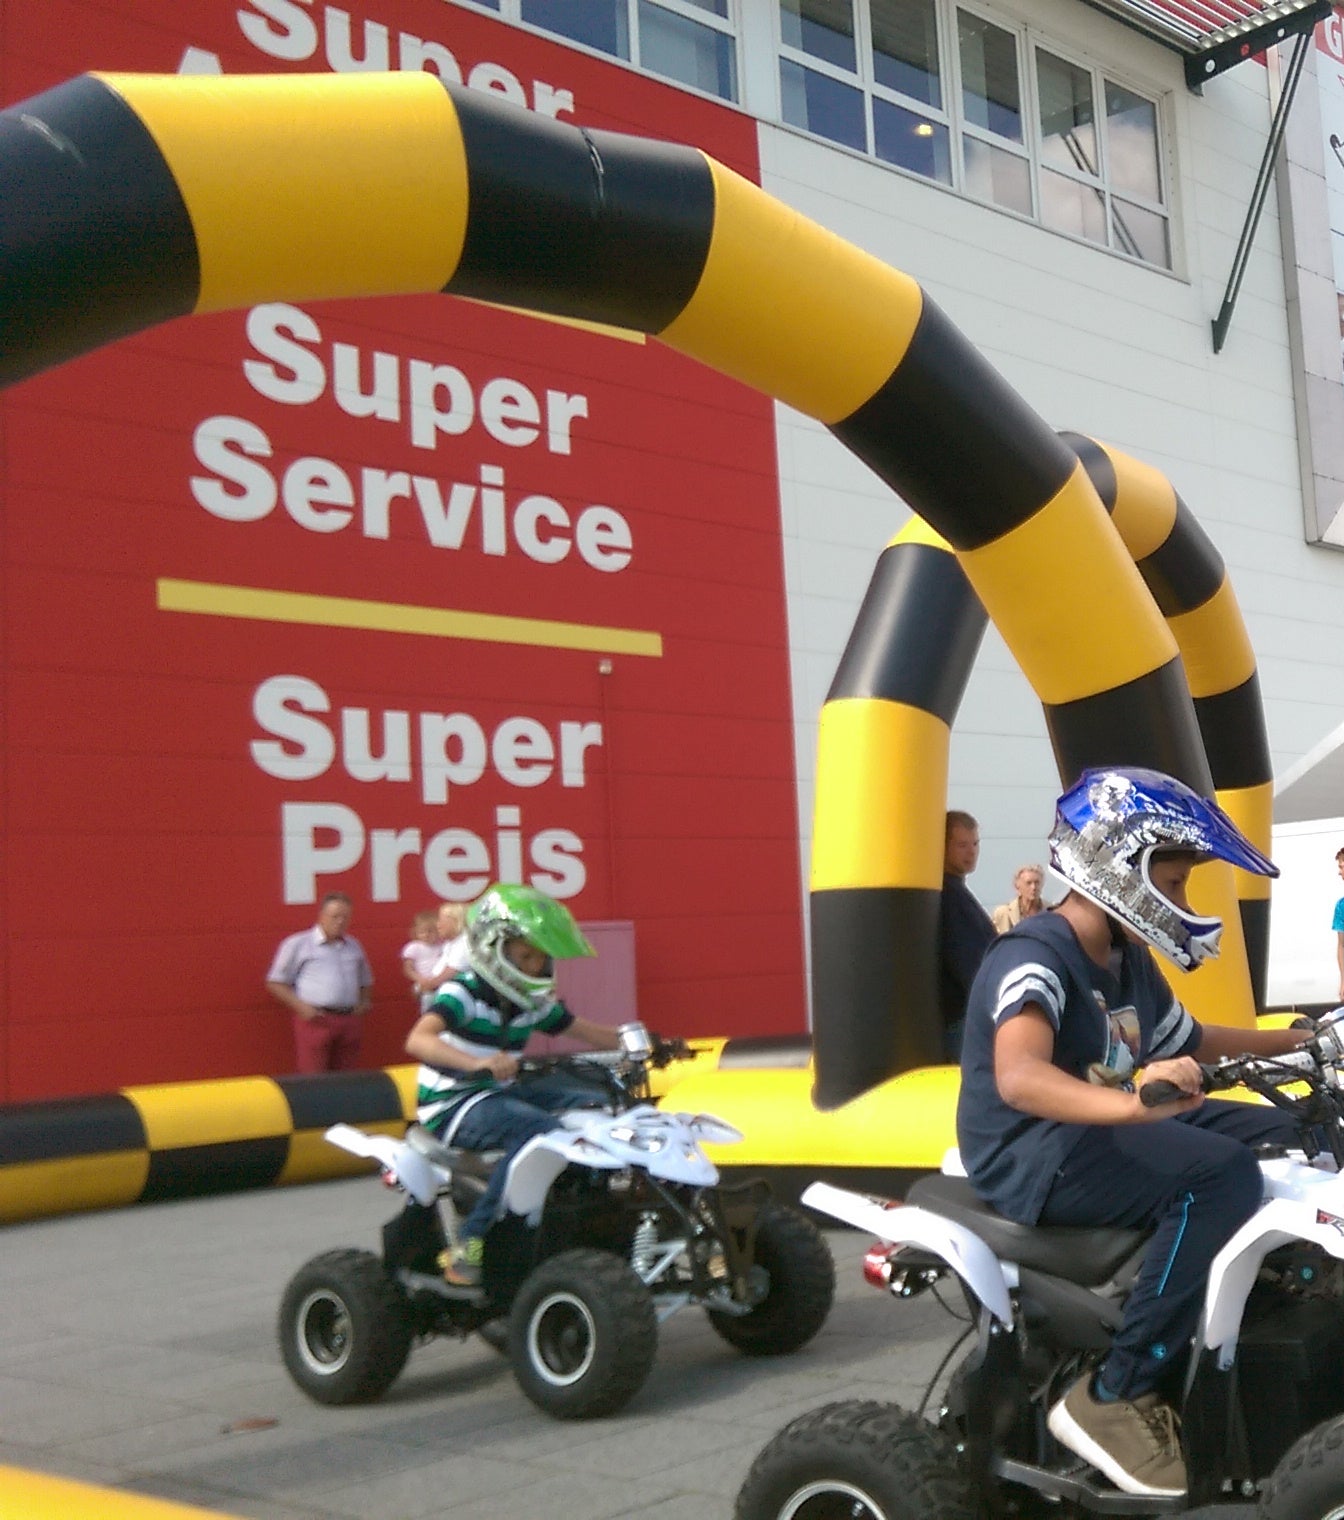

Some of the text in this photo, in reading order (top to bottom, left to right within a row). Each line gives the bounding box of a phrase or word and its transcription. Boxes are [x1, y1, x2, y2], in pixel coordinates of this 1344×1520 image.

[243, 302, 588, 454] Super
[190, 415, 633, 572] Service
[250, 675, 602, 804] Super
[281, 802, 586, 905] Preis
